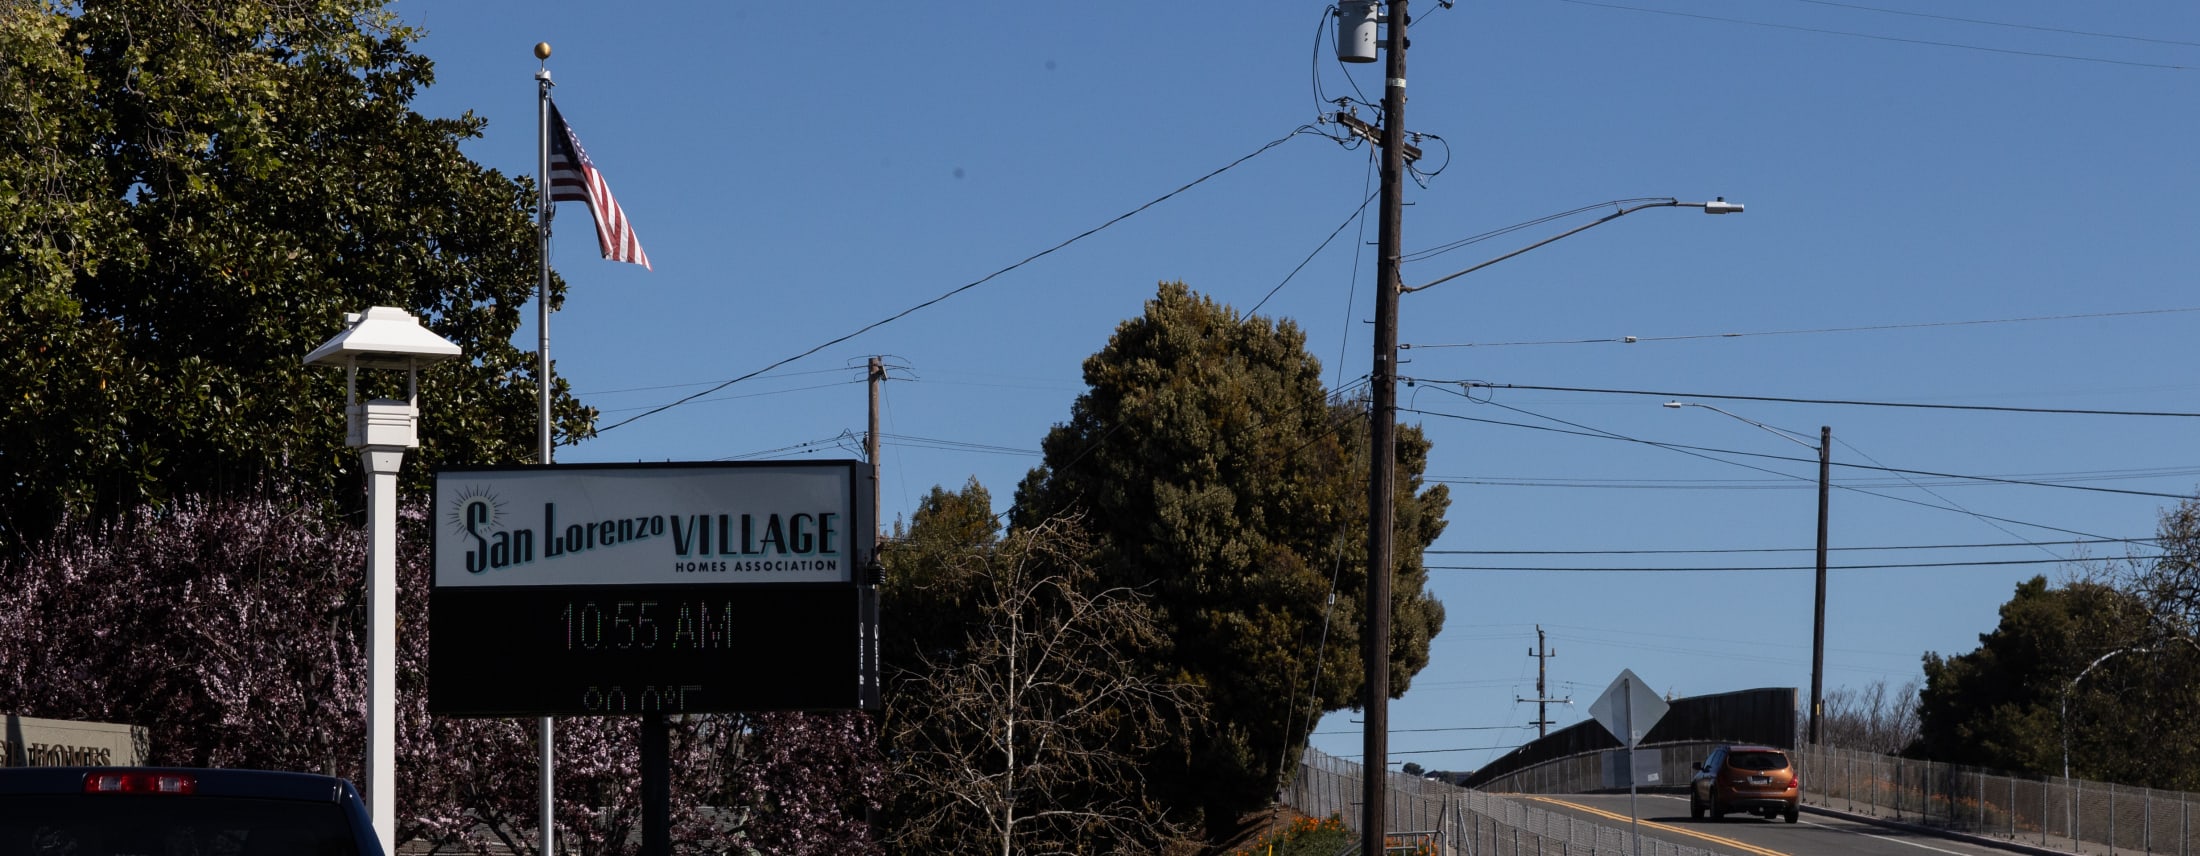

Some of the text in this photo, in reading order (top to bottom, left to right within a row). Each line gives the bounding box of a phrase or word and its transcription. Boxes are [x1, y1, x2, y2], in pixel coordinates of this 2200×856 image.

[465, 501, 839, 574] San Lorenzo VILLAGE
[675, 559, 837, 573] HOMES ASSOCIATION
[560, 600, 733, 650] 10:55 AM
